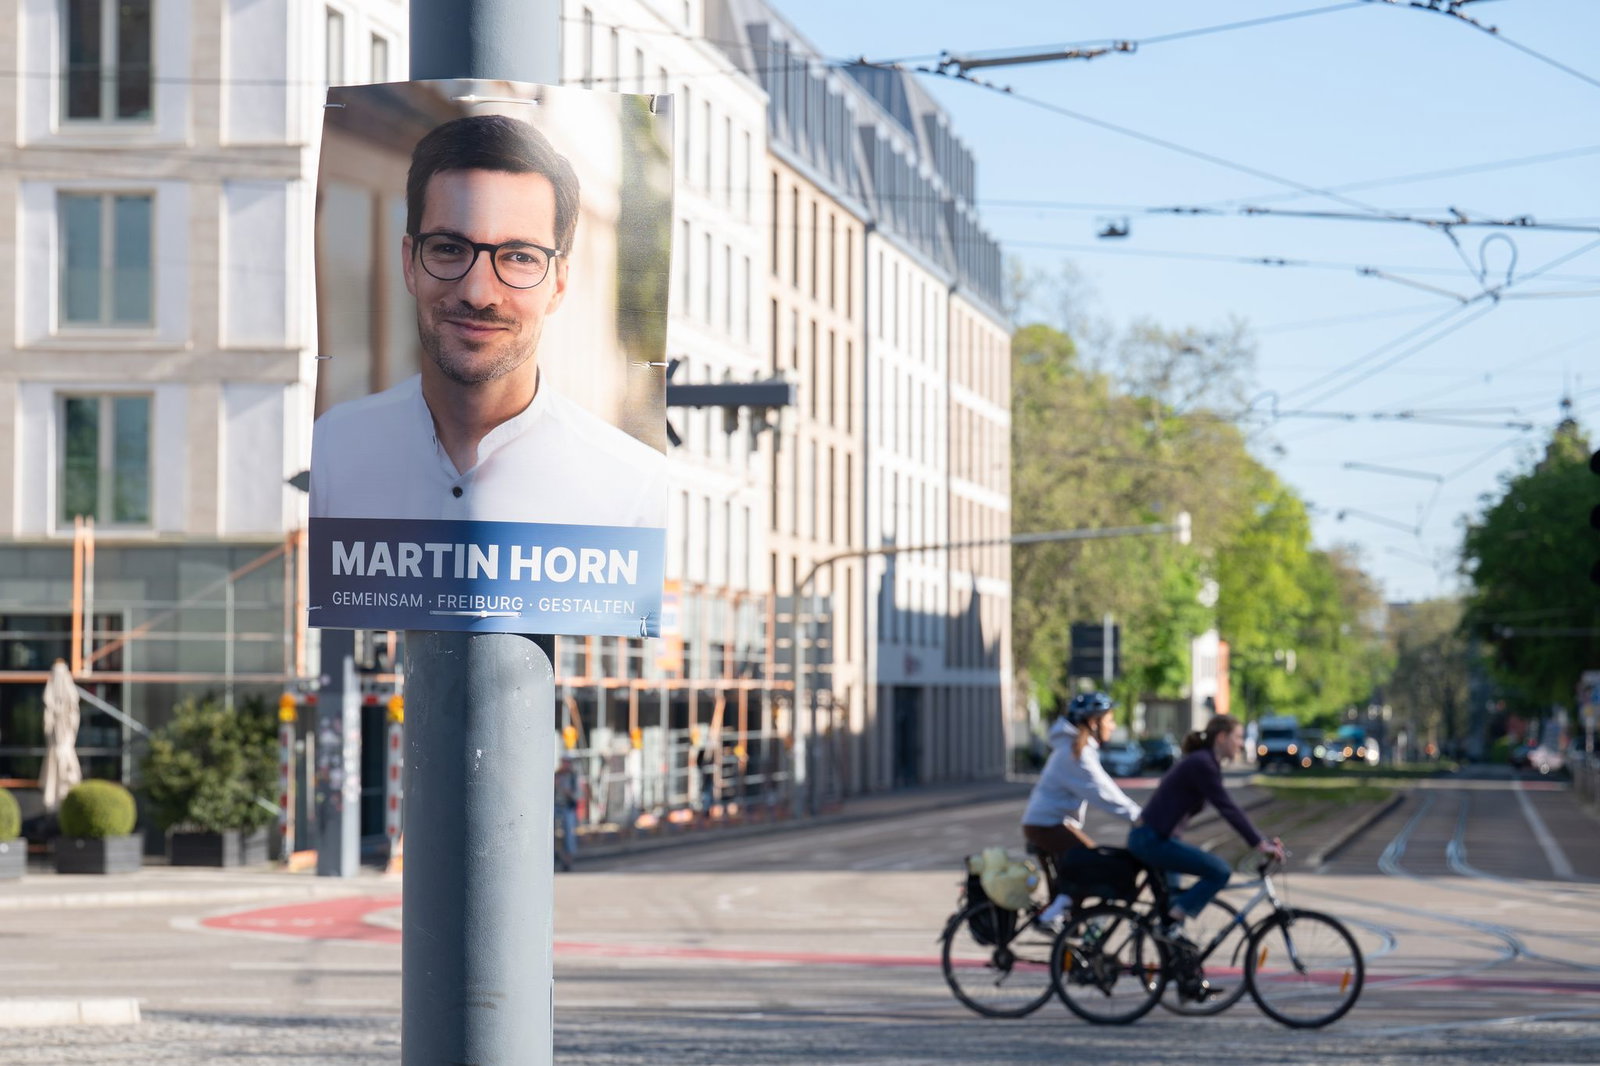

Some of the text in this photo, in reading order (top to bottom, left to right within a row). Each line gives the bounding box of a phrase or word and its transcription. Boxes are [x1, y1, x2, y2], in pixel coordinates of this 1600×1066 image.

[332, 541, 639, 585] MARTIN HORN
[332, 591, 635, 614] GEMEINSAM FREIBURG GESTALTEN
